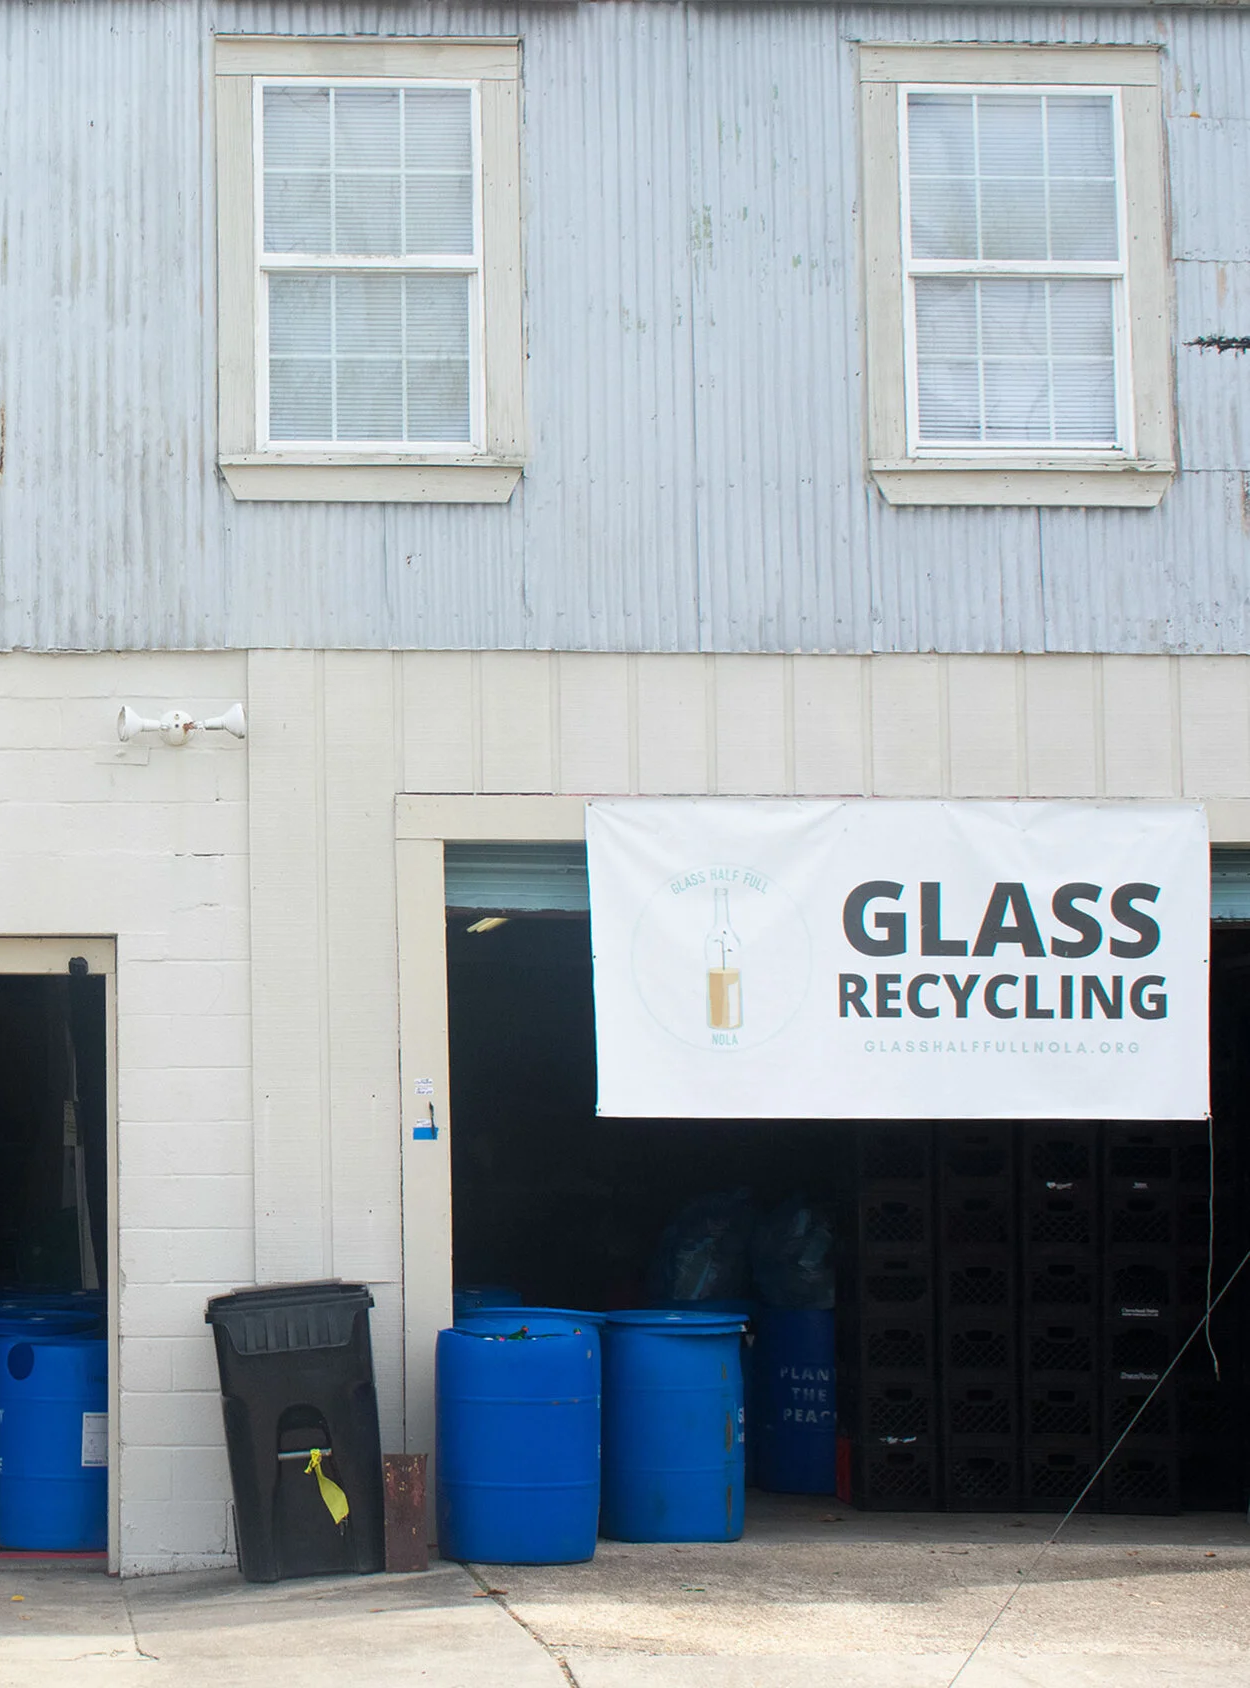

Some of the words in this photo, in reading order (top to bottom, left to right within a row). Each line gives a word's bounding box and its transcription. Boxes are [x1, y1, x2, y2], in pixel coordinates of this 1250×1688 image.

[670, 871, 706, 895] GLASS
[710, 868, 739, 882] HALF
[743, 872, 768, 895] FULL
[842, 880, 1161, 960] GLASS
[838, 973, 1168, 1021] RECYCLING
[711, 1033, 739, 1046] NOLA
[864, 1039, 1141, 1055] GLASSHALFFULLNOLA.ORG
[790, 1386, 828, 1403] THE
